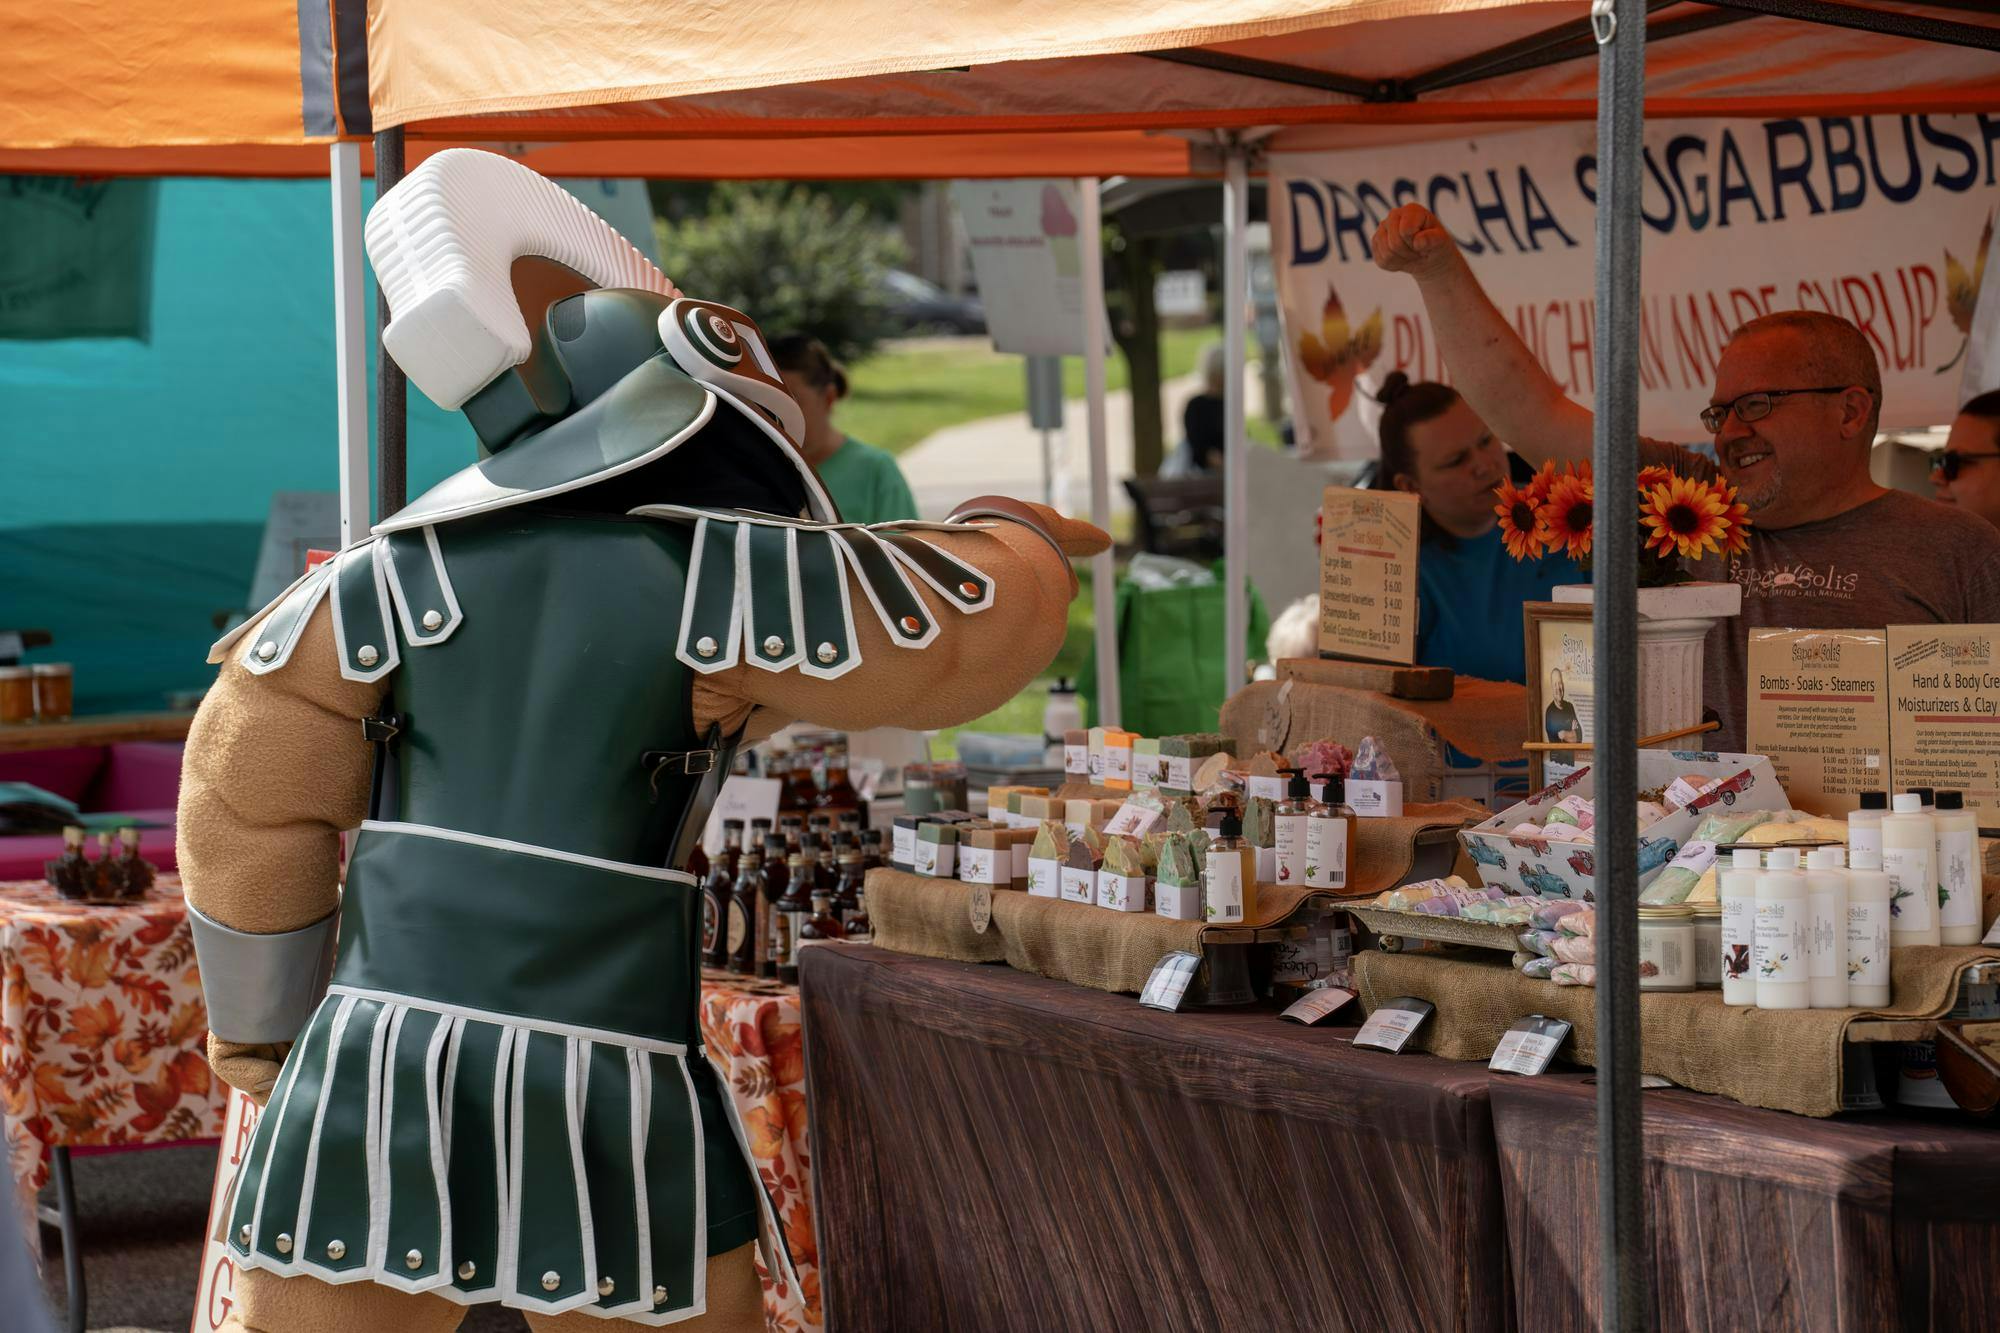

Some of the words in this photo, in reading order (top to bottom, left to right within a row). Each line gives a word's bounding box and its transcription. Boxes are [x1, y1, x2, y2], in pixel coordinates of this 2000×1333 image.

[1574, 114, 2000, 234] UGARBUS
[1325, 556, 1340, 570] Large
[1341, 557, 1352, 569] Bars
[1325, 572, 1339, 584] Small
[1341, 574, 1352, 586] Bars
[1324, 589, 1351, 603] Unscented
[1352, 593, 1374, 606] Varieties
[1324, 604, 1348, 619] Shampoo
[1348, 608, 1360, 621] Bars
[1323, 621, 1336, 635] Solid
[1338, 624, 1368, 640] Conditioner
[1369, 628, 1381, 642] Bars
[1760, 675, 1789, 690] Bombs
[1797, 676, 1823, 691] Soaks
[1831, 676, 1875, 692] Steamers
[1913, 674, 1939, 689] Hand
[1943, 674, 1951, 689] &
[1955, 673, 1980, 692] Body
[1898, 697, 1959, 712] Moisturizers
[1963, 698, 1971, 712] &
[1975, 697, 1997, 716] Clay
[1948, 760, 1960, 768] Body
[1905, 769, 1935, 778] Moisturizing
[1958, 770, 1970, 779] Body
